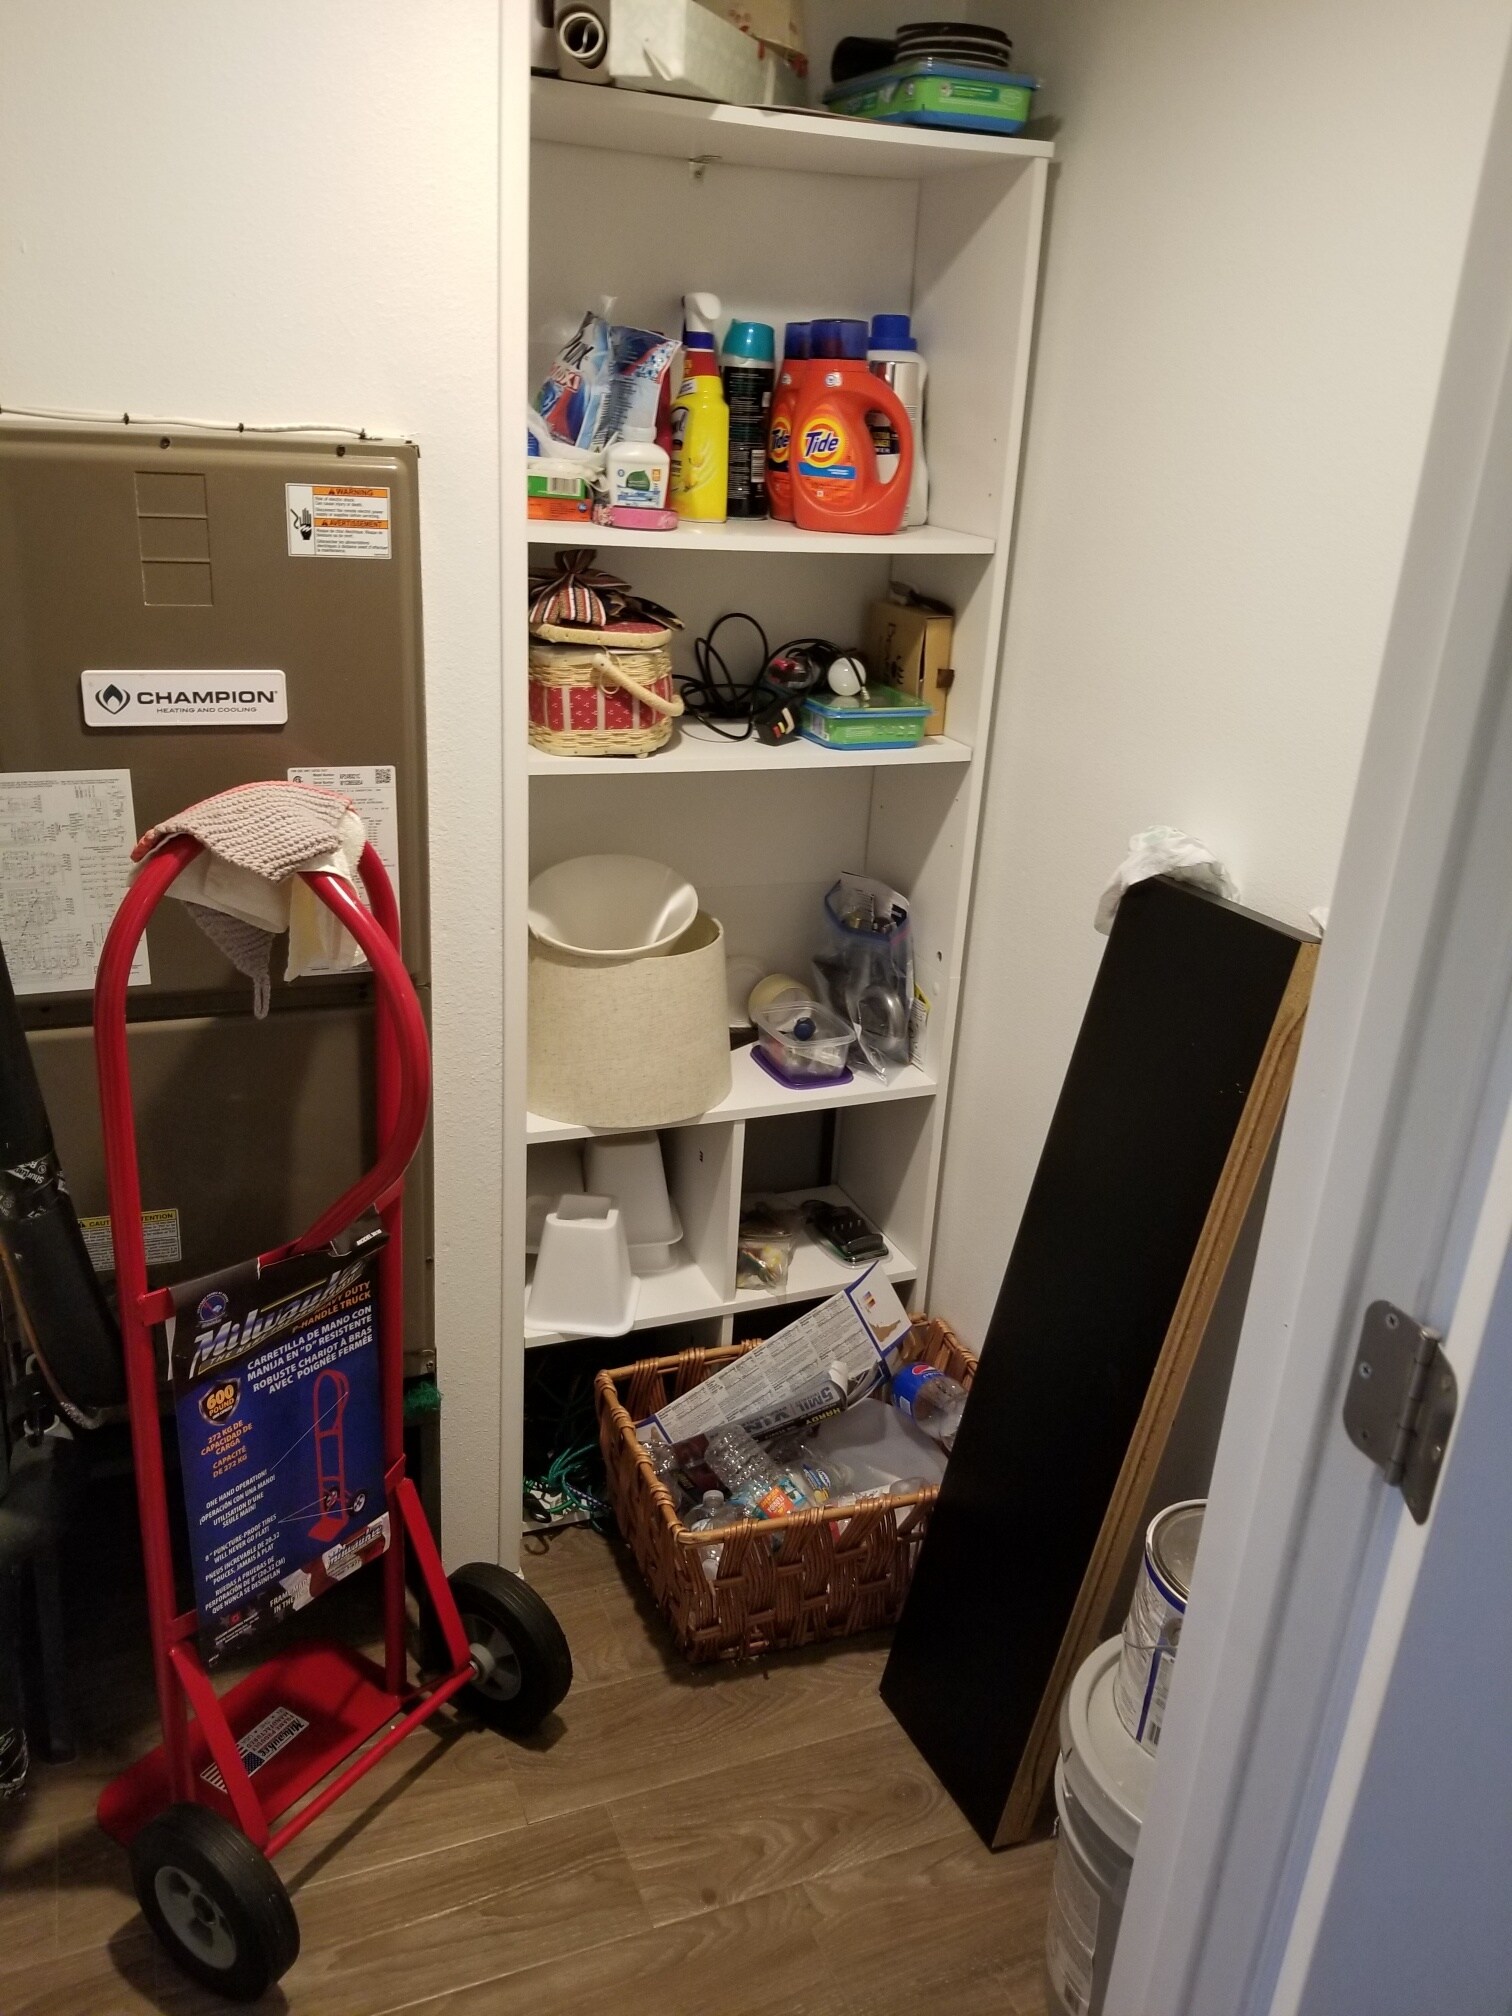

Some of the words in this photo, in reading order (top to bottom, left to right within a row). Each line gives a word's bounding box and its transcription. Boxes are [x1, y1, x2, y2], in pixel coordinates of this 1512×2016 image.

[804, 429, 840, 458] Tide
[336, 488, 374, 496] WARNING
[137, 690, 275, 704] CHAMPION
[14, 1167, 45, 1184] Shurtap
[141, 1213, 173, 1221] TENTION
[345, 1281, 370, 1298] DUTY
[341, 1291, 371, 1310] TRUCK
[247, 1336, 305, 1370] CARRETILLA
[307, 1329, 319, 1341] DE
[321, 1315, 350, 1334] MANO
[352, 1305, 371, 1319] CON
[247, 1358, 284, 1381] MANIJA
[286, 1349, 299, 1361] EN
[319, 1314, 372, 1347] RESISTENTE
[253, 1364, 297, 1392] ROBUSTE
[298, 1342, 339, 1368] CHARIOT
[349, 1326, 372, 1342] BRAS
[269, 1375, 293, 1394] AVEC
[207, 1384, 234, 1410] 600
[209, 1398, 234, 1416] POUND
[806, 1407, 840, 1425] HARDY
[201, 1429, 242, 1456] CAPACIDAD
[242, 1423, 253, 1434] DE
[208, 1432, 221, 1444] 272
[222, 1426, 233, 1436] KG
[233, 1420, 243, 1430] DE
[216, 1438, 240, 1455] CARGA
[213, 1469, 223, 1478] DE
[223, 1460, 237, 1472] 272
[237, 1454, 248, 1465] KG
[206, 1498, 218, 1509] ONE
[219, 1488, 235, 1502] HAND
[233, 1493, 244, 1504] CON
[213, 1502, 246, 1526] UTILISATION
[222, 1514, 239, 1528] SEULE
[213, 1523, 261, 1556] PUNCTURE-PROOF
[262, 1513, 277, 1527] TIRES
[213, 1551, 228, 1564] WILL
[228, 1541, 246, 1554] NEVER
[247, 1535, 255, 1544] GO
[261, 1543, 274, 1555] PLAT
[205, 1566, 224, 1582] PNEUS
[224, 1545, 257, 1571] INCREVABLE
[257, 1540, 264, 1550] DE
[212, 1603, 223, 1614] QUE
[224, 1592, 243, 1607] NUNCA
[244, 1586, 251, 1595] SE
[251, 1569, 281, 1590] DESINFLAN
[243, 1578, 250, 1587] DE
